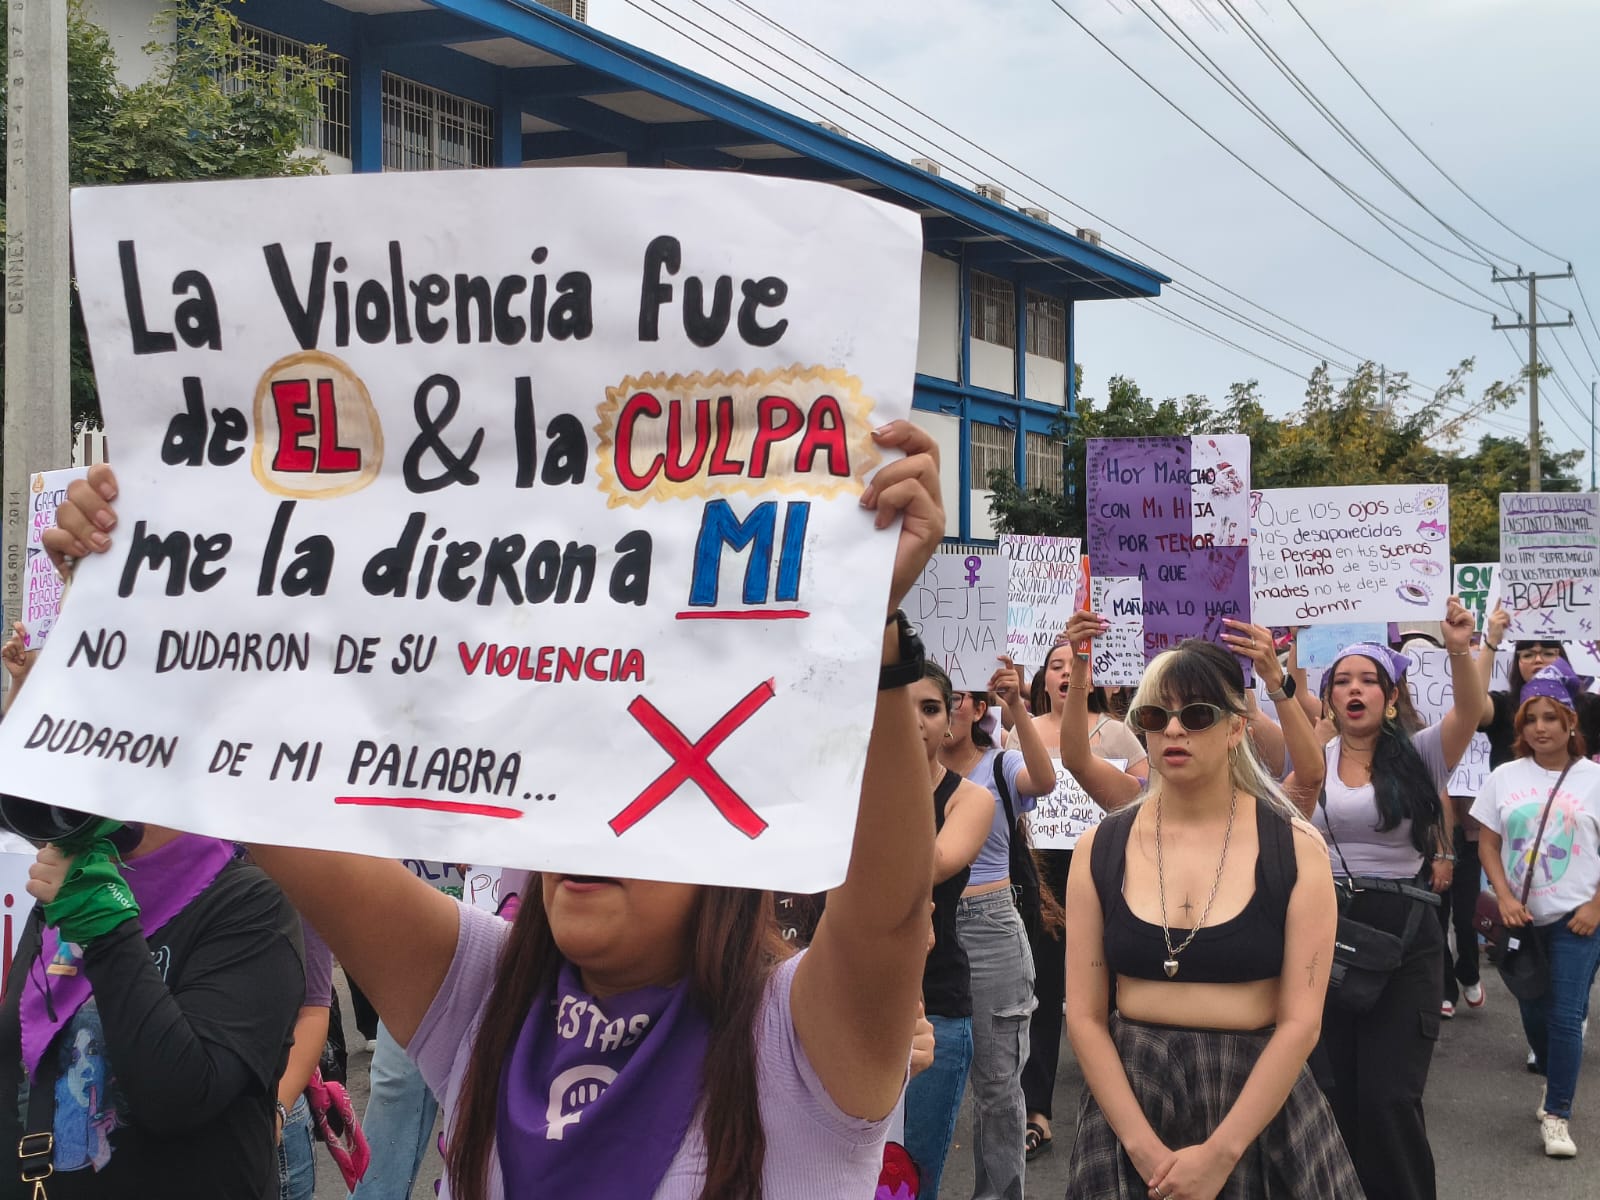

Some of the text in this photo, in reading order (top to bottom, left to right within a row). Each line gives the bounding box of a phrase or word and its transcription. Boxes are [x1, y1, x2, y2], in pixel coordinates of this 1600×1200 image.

[118, 235, 788, 354] La Violencia fue
[161, 373, 850, 493] de EL & la CULPA
[1100, 503, 1130, 519] CON
[1258, 501, 1301, 527] Que
[1348, 500, 1389, 522] ojos
[1394, 497, 1414, 515] de
[1293, 521, 1402, 545] desaparecidas
[1501, 515, 1594, 532] INSTINTO ANIMAL
[118, 520, 232, 598] me
[257, 501, 335, 597] la
[688, 499, 811, 606] MI
[1118, 533, 1215, 552] POR TEMOR
[1259, 546, 1276, 561] te
[1336, 547, 1353, 559] en
[1504, 552, 1517, 564] NO
[1518, 551, 1536, 564] HAY
[1138, 563, 1187, 582] A QUE
[1259, 565, 1269, 585] y
[1273, 563, 1289, 579] el
[1295, 562, 1334, 579] llanto
[1342, 562, 1361, 573] de
[1254, 577, 1389, 600] madres no te deje
[1508, 580, 1591, 613] BOZAL
[919, 586, 997, 621] DEJE
[1113, 598, 1241, 617] MAÑANA LO HAGA
[1295, 599, 1362, 619] dormir
[942, 625, 997, 653] UNA
[66, 628, 646, 682] NO DUDARON DE SU VIOLENCIA
[1092, 650, 1117, 677] #8M
[24, 714, 179, 768] DUDARON
[208, 740, 252, 777] DE
[269, 741, 323, 781] MI
